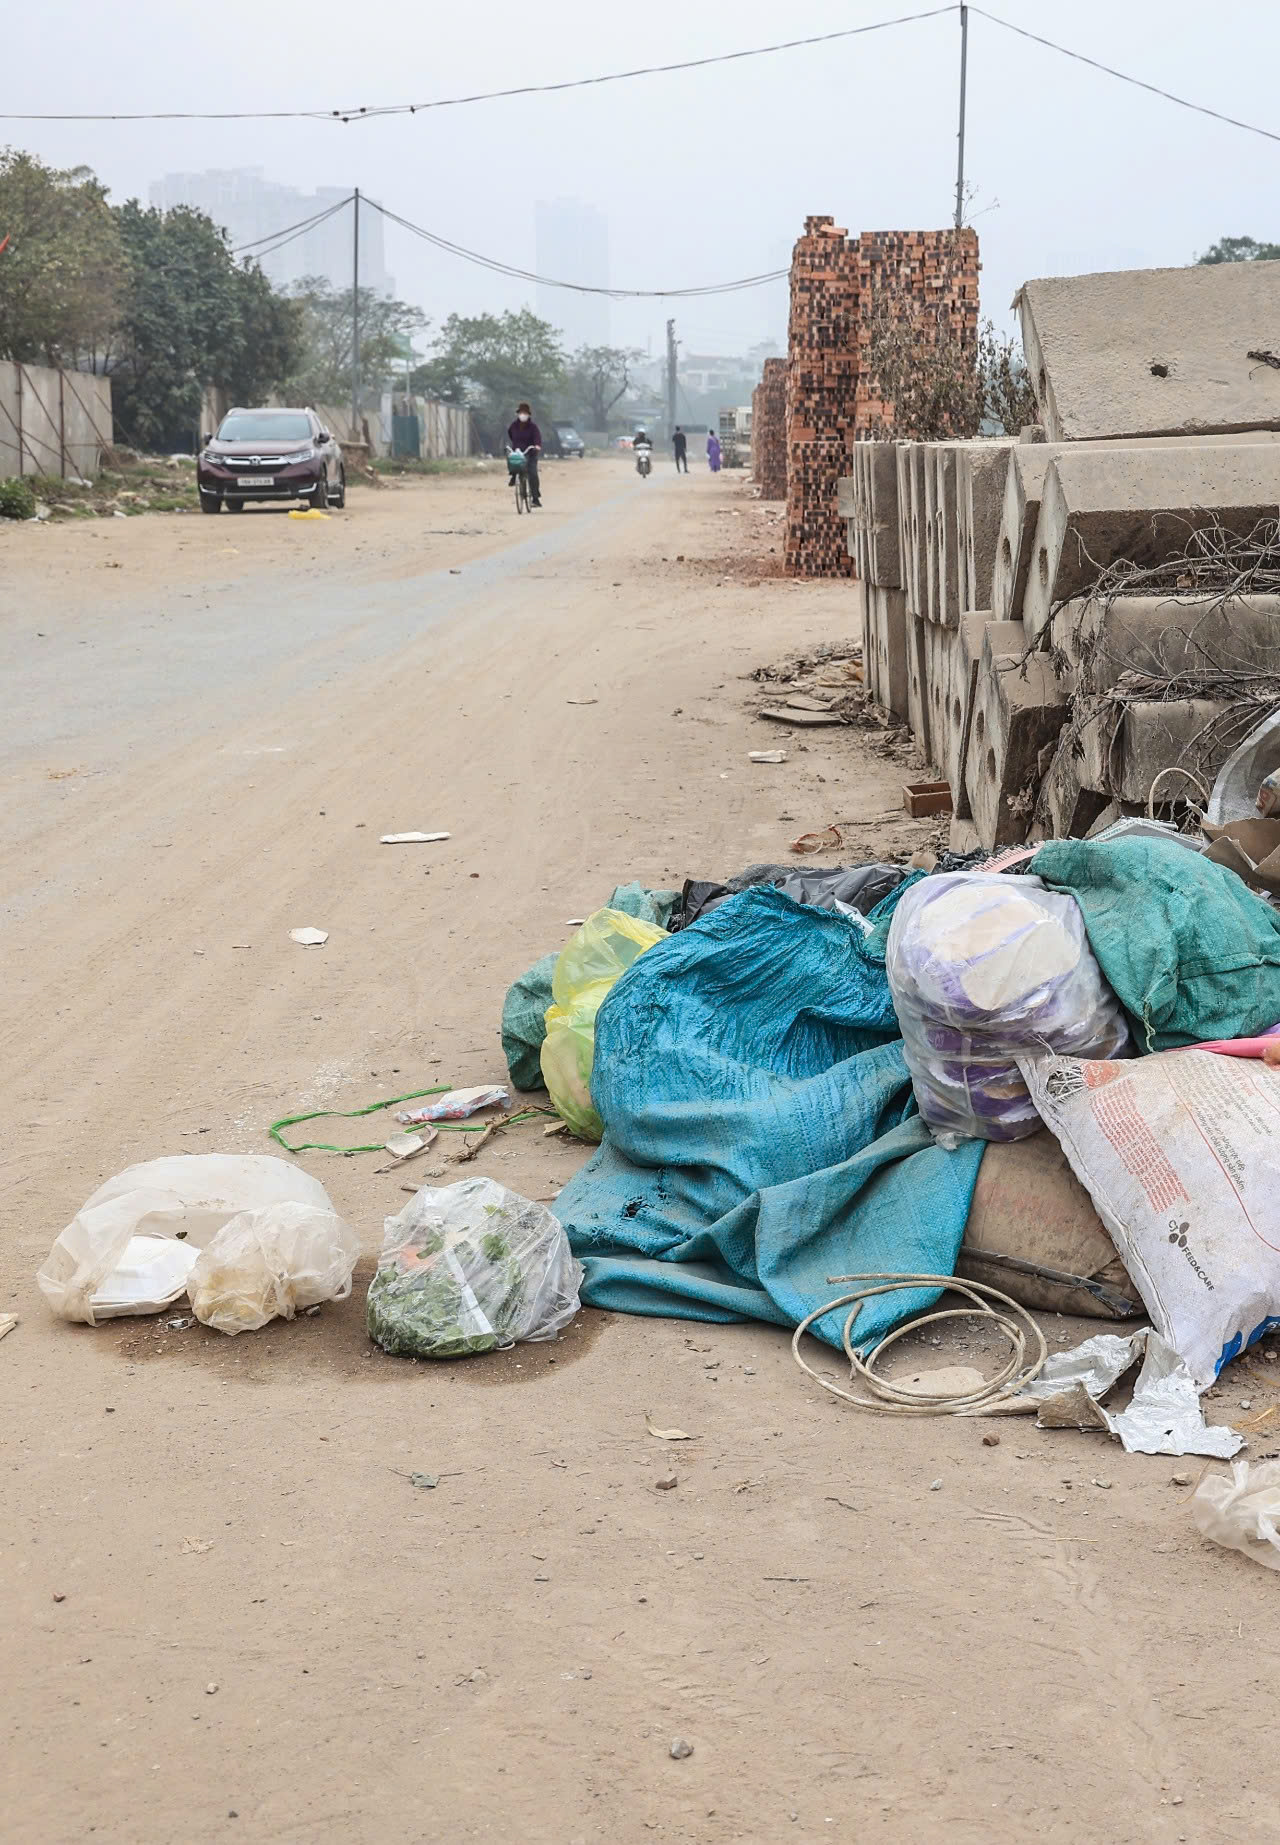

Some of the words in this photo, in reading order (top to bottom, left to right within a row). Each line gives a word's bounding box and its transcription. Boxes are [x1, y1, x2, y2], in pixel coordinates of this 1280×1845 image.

[1226, 1161, 1237, 1174] sản
[1231, 1171, 1246, 1190] phẩm
[1166, 1219, 1179, 1232] CJ
[1180, 1246, 1214, 1291] FEED&CARE
